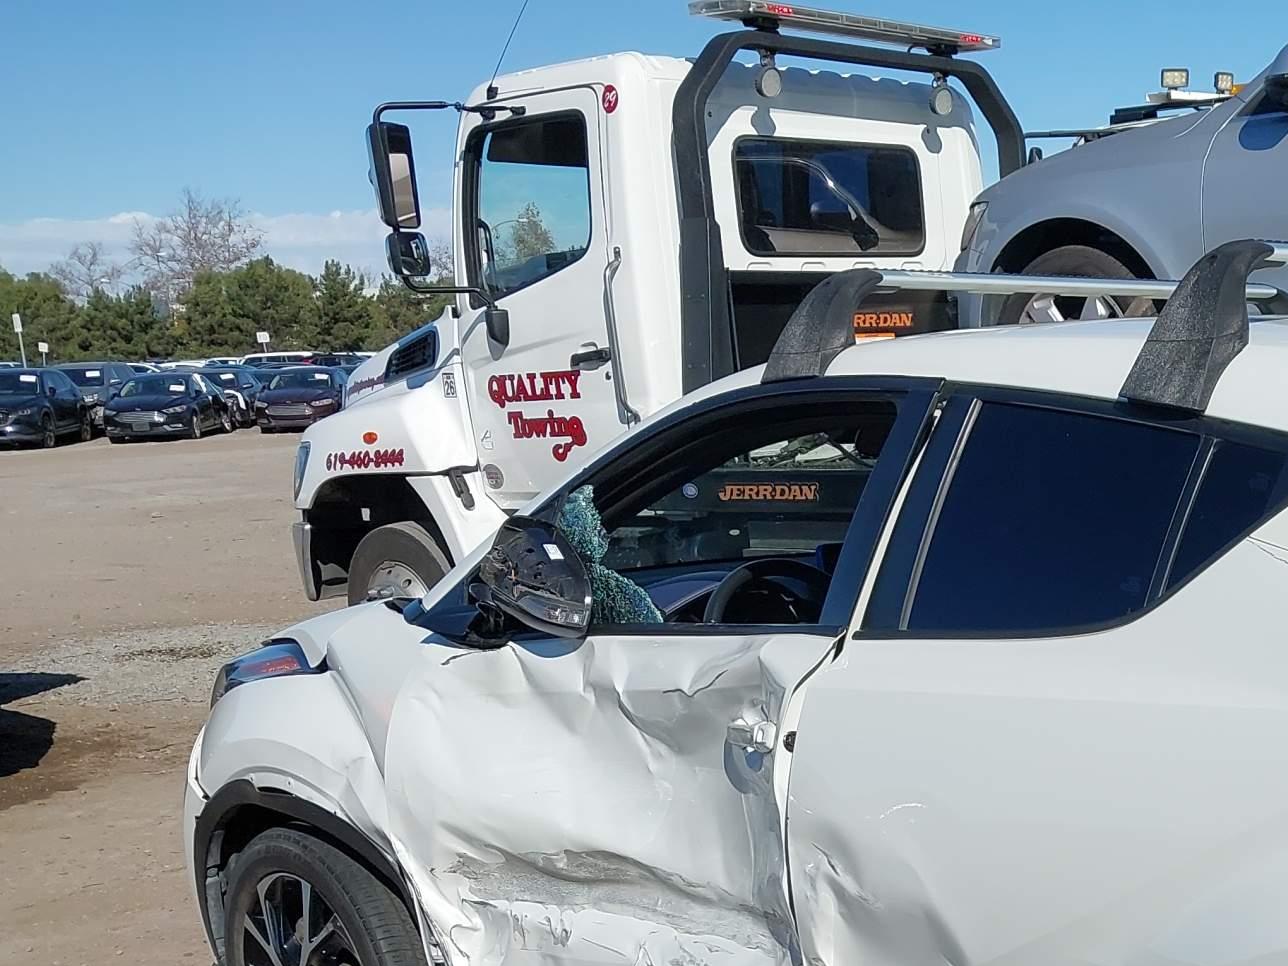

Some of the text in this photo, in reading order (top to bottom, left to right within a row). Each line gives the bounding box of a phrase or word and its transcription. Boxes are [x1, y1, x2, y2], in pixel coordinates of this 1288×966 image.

[603, 90, 617, 108] 29
[445, 380, 454, 395] 26
[487, 369, 582, 409] QUALITY
[507, 408, 588, 462] Towing
[326, 448, 405, 472] 619-460-8444
